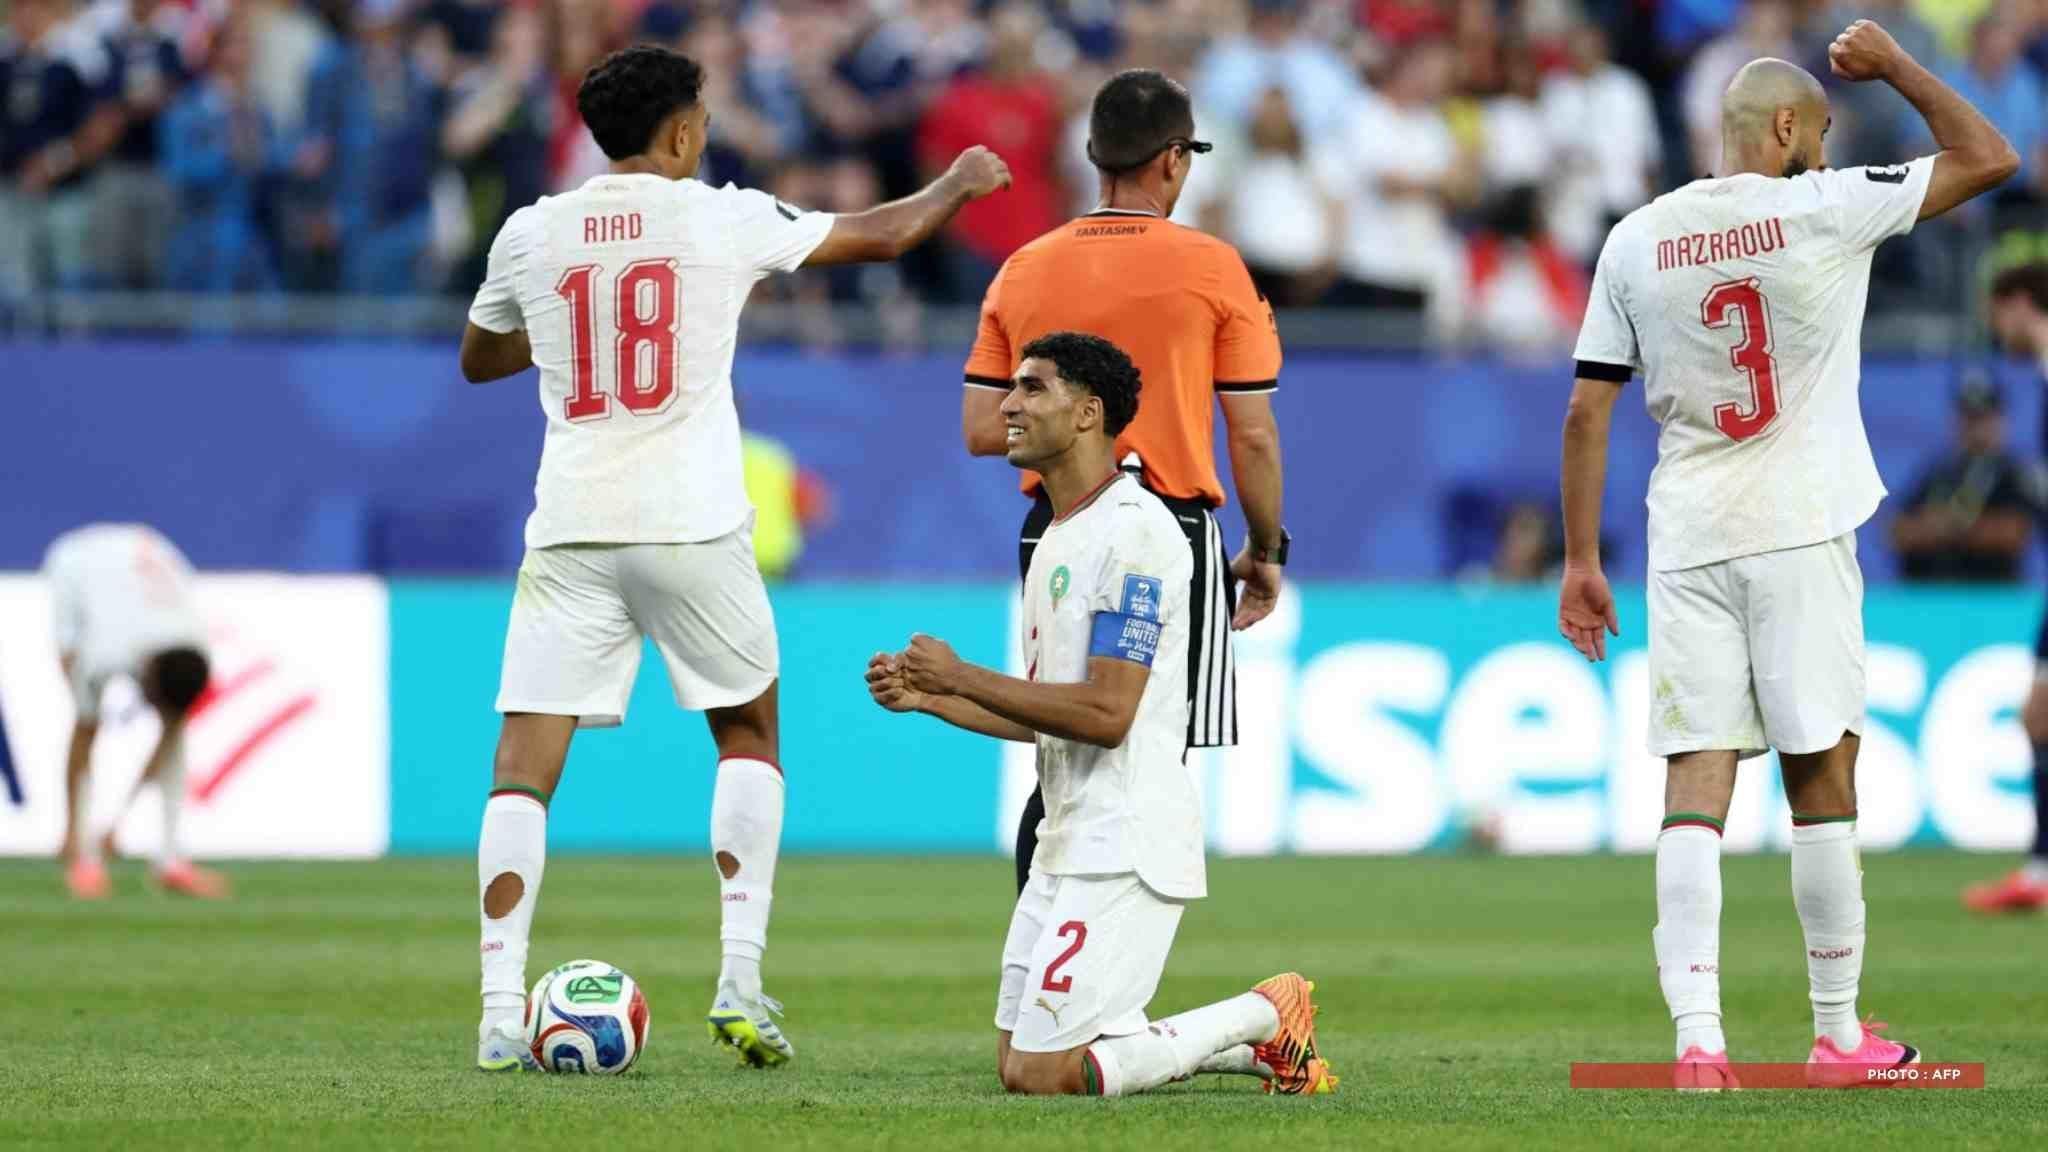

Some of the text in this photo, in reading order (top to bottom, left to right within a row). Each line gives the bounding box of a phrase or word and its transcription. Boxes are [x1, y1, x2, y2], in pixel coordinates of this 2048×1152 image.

[584, 212, 643, 244] RIAD
[1075, 225, 1148, 237] TANTASHEV
[1657, 217, 1786, 272] MAZRAOUI
[554, 256, 682, 424] 18
[1700, 275, 1782, 443] 3
[1003, 578, 2042, 856] isese
[1041, 920, 1088, 993] 2
